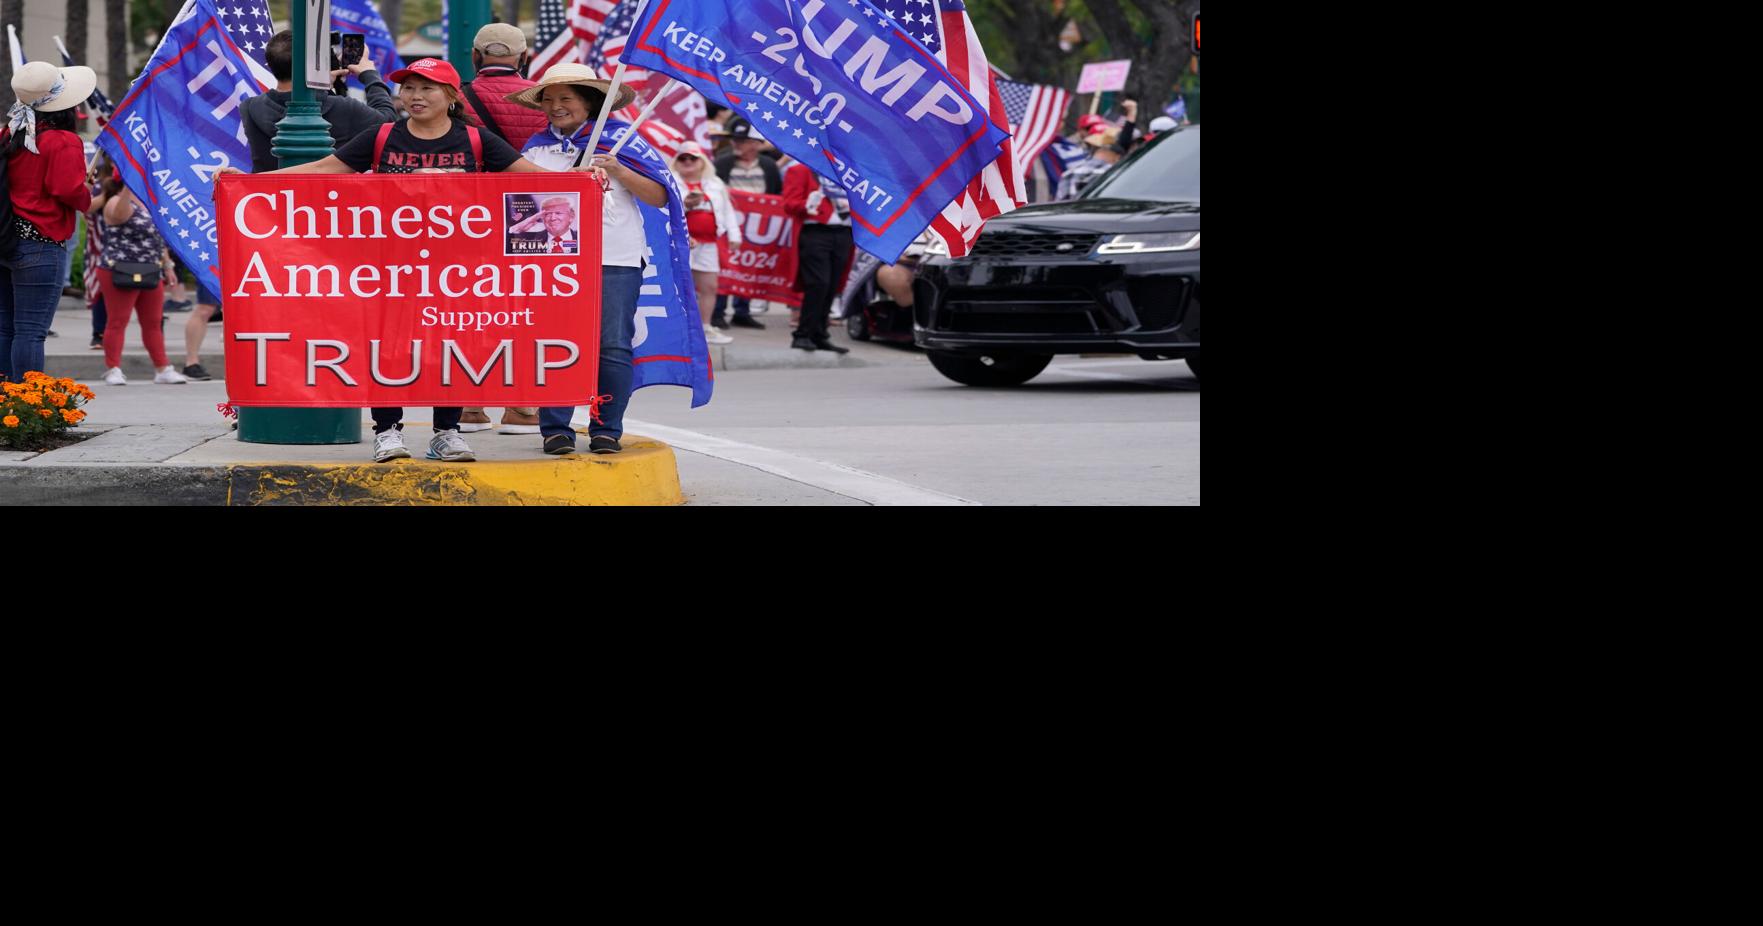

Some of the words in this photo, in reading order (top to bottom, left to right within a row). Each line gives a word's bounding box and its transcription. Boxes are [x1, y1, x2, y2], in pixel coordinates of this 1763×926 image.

[663, 21, 726, 63] KEEP
[722, 64, 823, 129] AMERIC
[124, 110, 161, 163] KEEP
[386, 152, 467, 166] NEVER
[234, 190, 492, 240] Chinese
[231, 249, 580, 298] Americans
[728, 249, 779, 269] 2024
[421, 306, 534, 331] Support
[234, 332, 580, 387] TRUMP
